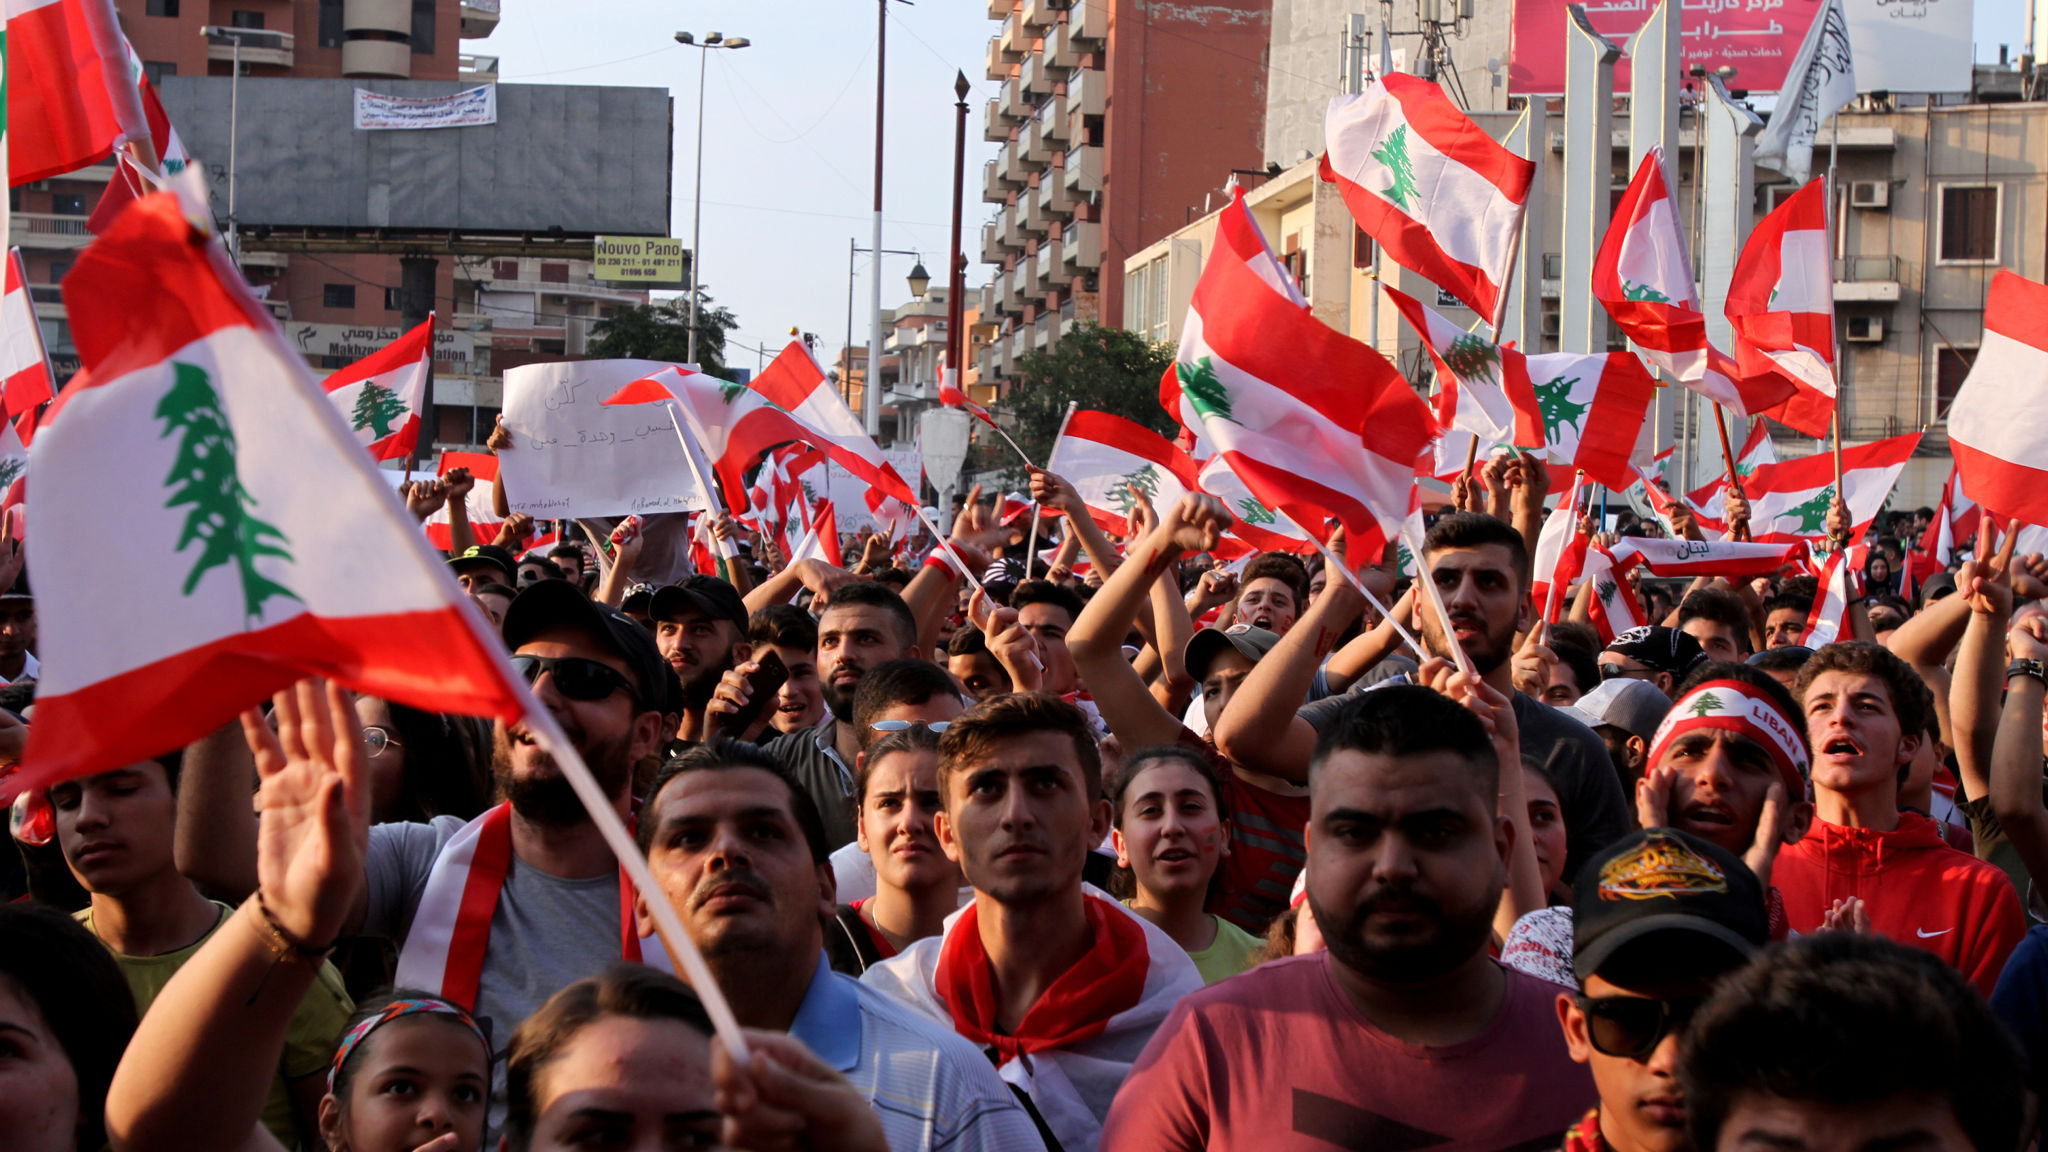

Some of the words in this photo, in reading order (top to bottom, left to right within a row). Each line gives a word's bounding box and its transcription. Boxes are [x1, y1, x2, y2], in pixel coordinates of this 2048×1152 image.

[1890, 6, 1927, 18] لبنان
[597, 241, 640, 255] Nouvo
[646, 241, 679, 256] Pano
[1677, 541, 1709, 560] لبنان
[1752, 704, 1799, 756] LIBAN
